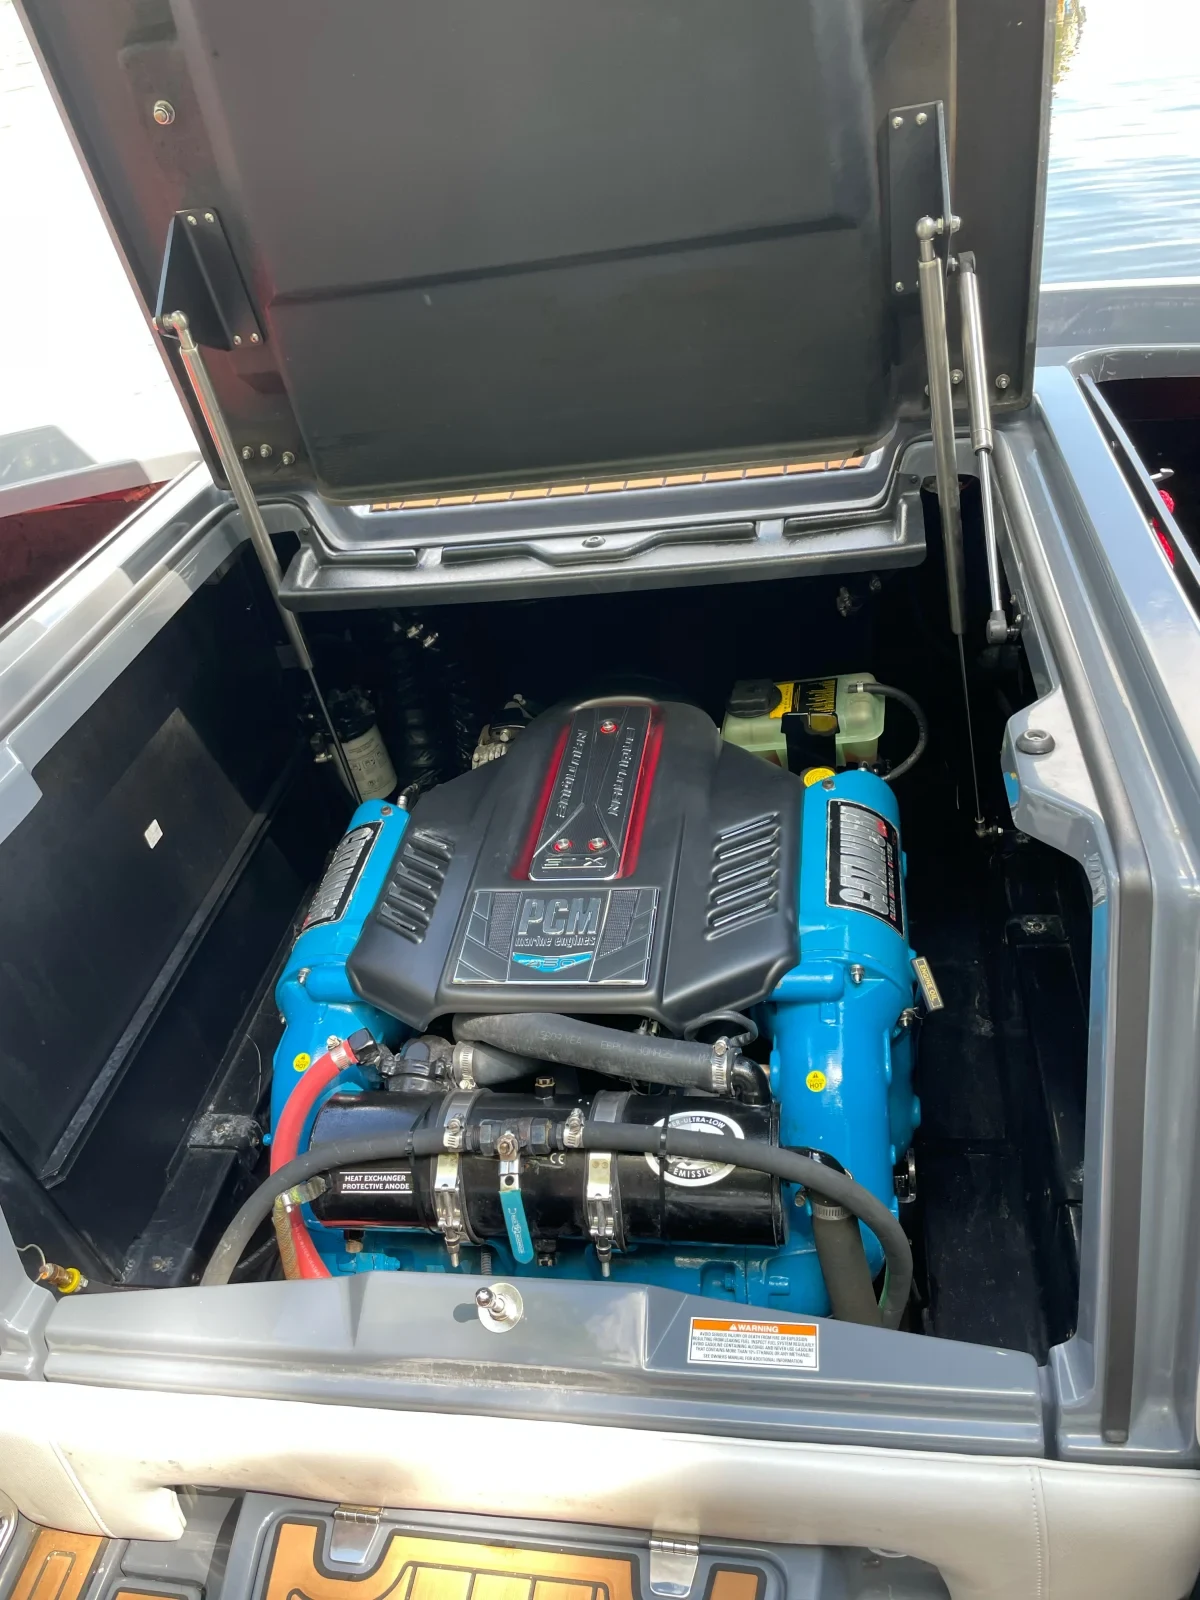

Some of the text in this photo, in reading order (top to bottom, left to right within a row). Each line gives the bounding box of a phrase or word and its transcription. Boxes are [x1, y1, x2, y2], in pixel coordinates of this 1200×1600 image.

[517, 898, 601, 935] PCM
[515, 935, 596, 948] marine engines
[523, 959, 577, 969] 450
[920, 964, 932, 989] ENGINE
[668, 1117, 726, 1128] PER-ULTRA-LOW
[673, 1163, 720, 1178] EMISSION
[738, 1324, 778, 1333] WARNING
